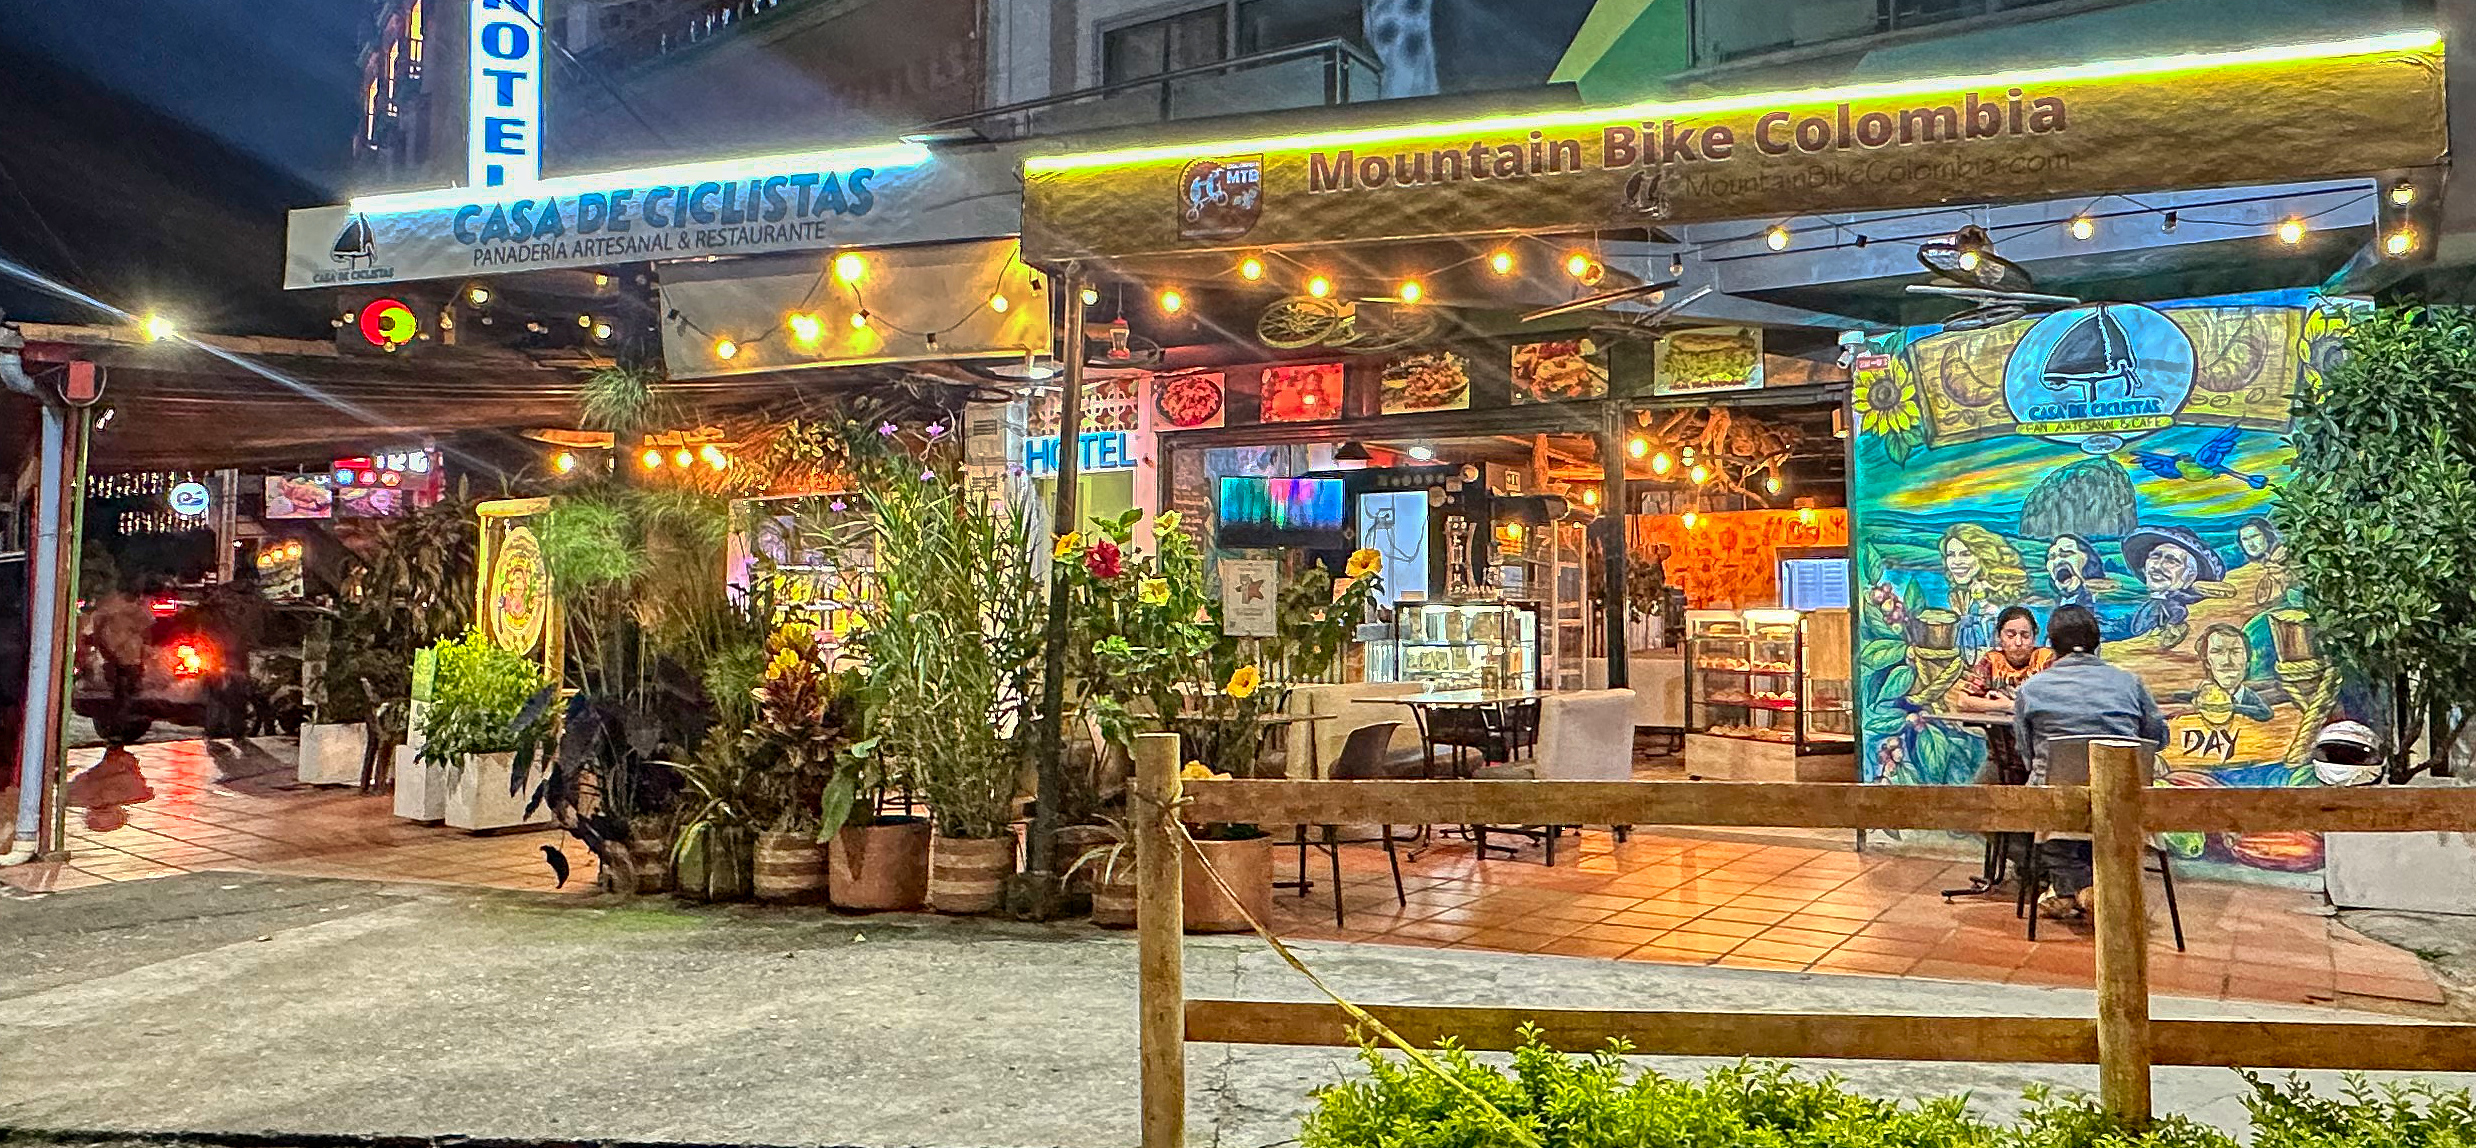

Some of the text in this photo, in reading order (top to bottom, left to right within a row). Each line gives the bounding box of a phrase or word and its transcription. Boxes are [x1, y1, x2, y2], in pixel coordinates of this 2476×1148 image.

[482, 0, 529, 187] OTE
[1308, 88, 2067, 194] Mountain Bike Colombia
[1226, 168, 1260, 184] MTB
[453, 167, 875, 245] CASA DE CICLISTAS
[572, 232, 674, 259] ARTESANAL
[677, 230, 691, 250] &
[695, 220, 827, 249] RESTAURANTE
[2028, 399, 2164, 421] CASA DE CICLISTAS
[2182, 728, 2241, 764] DAY
